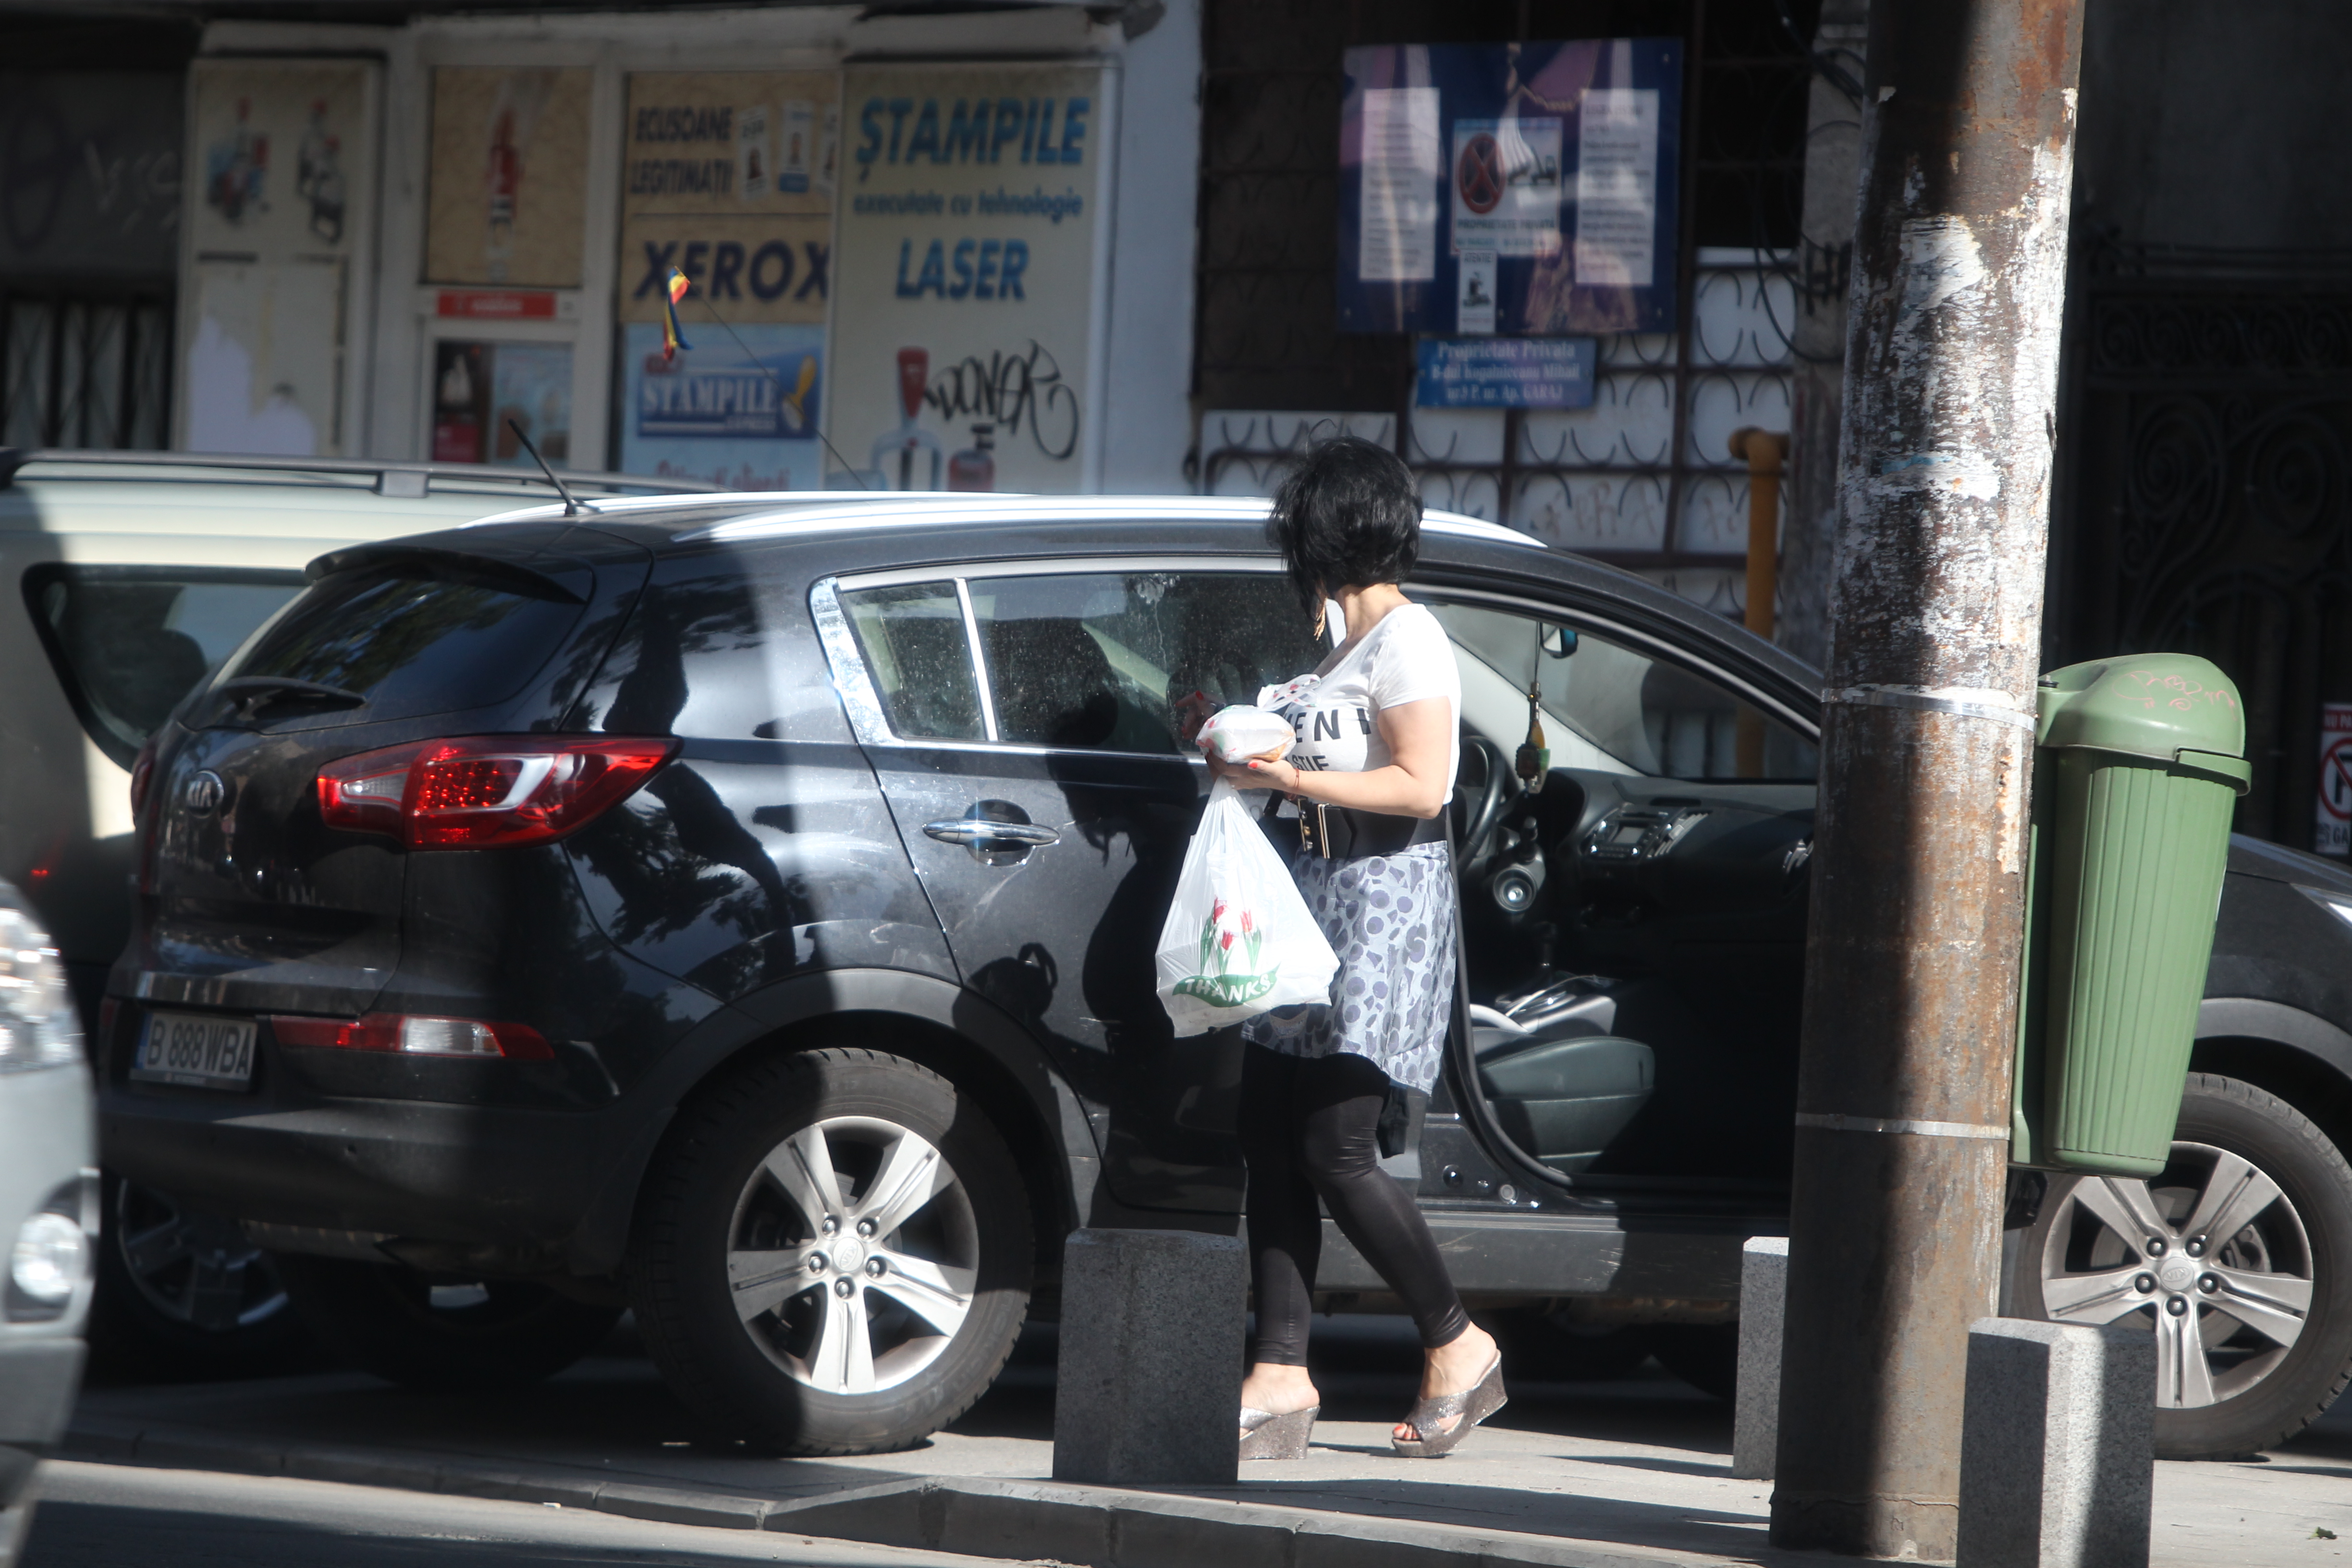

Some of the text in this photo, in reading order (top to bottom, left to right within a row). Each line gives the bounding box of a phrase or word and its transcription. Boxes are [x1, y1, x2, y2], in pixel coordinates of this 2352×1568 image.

[632, 239, 830, 303] XEROX
[895, 237, 1029, 301] LASER
[1438, 340, 1519, 362] Proprietate
[1542, 363, 1580, 379] Mihail
[1185, 974, 1271, 1002] THANKS
[147, 1019, 250, 1075] B 888 WBA
